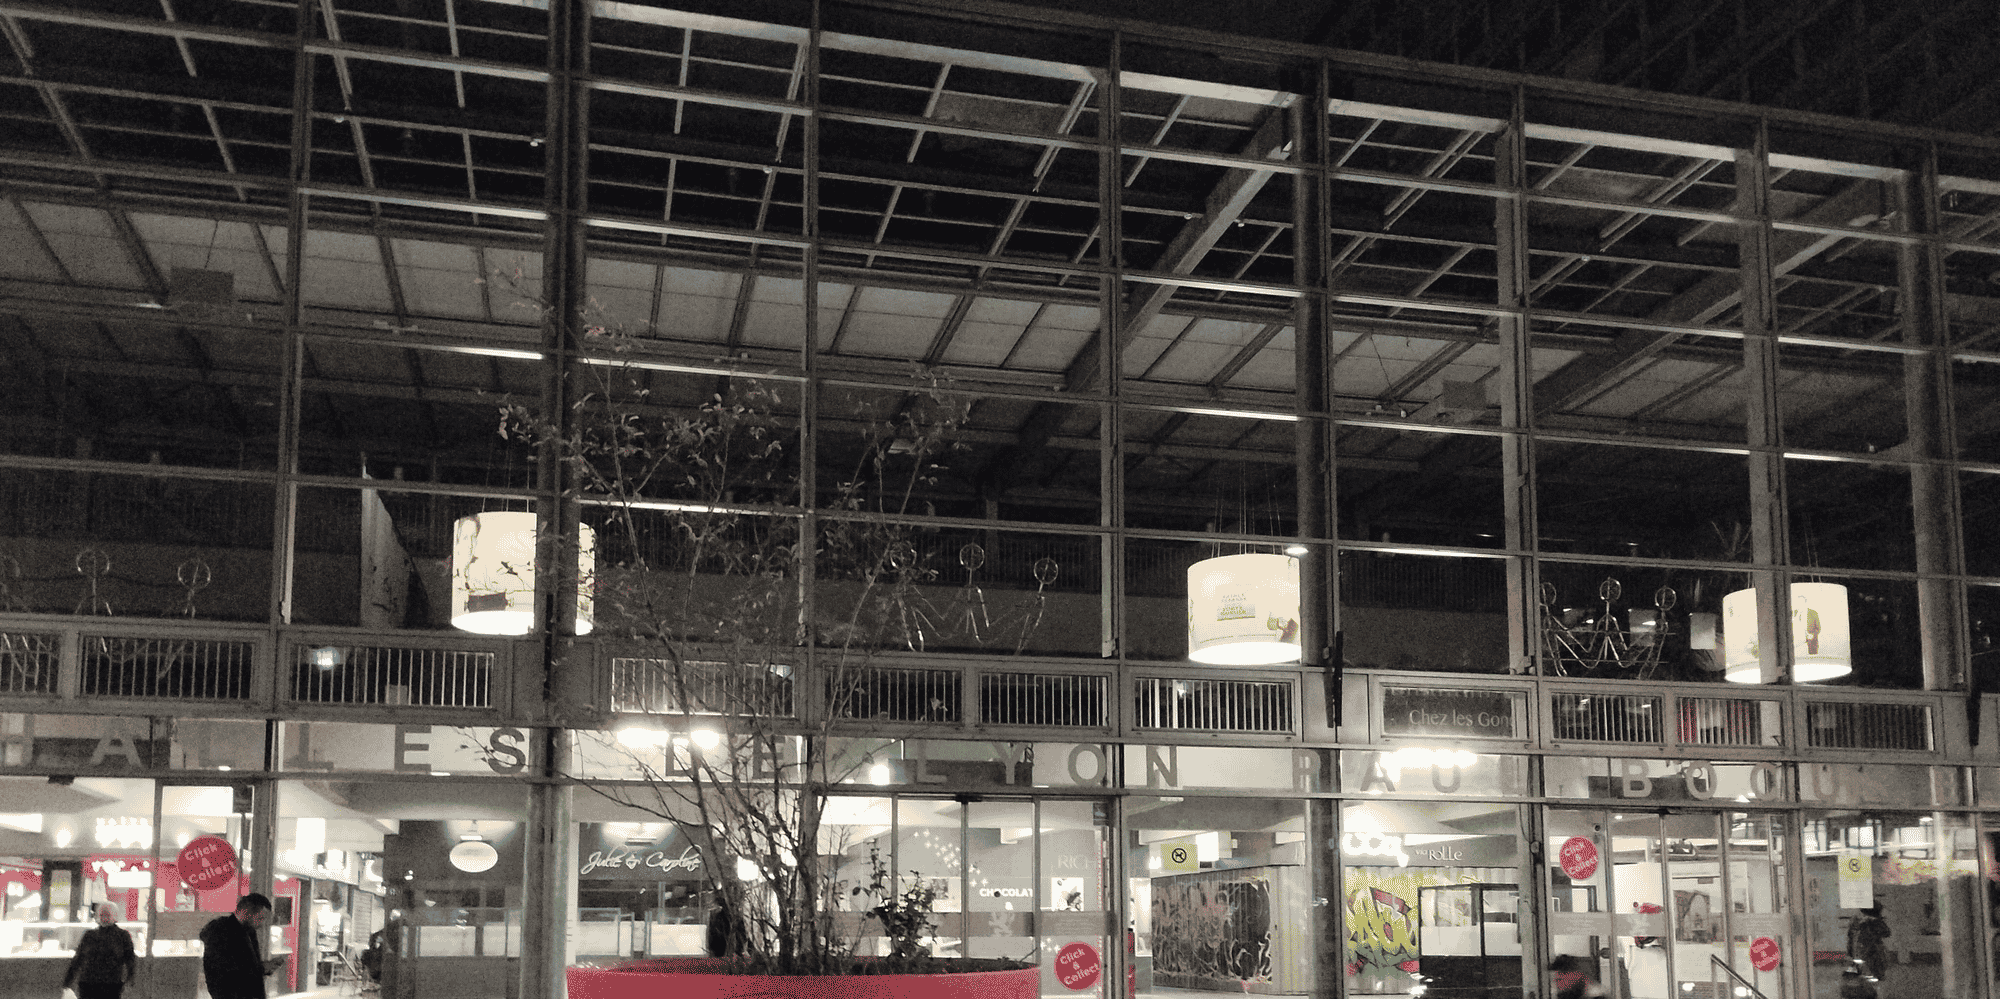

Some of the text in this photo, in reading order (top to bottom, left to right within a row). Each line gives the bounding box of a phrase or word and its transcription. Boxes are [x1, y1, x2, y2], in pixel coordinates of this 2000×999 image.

[1408, 707, 1448, 726] Chez
[1452, 709, 1474, 727] les
[916, 738, 1178, 788] LYON
[184, 843, 218, 861] Click
[1564, 842, 1584, 856] Click
[579, 845, 630, 875] Julie
[645, 844, 703, 873] Caroline
[1569, 855, 1598, 874] Collect
[188, 860, 235, 884] Collect
[1060, 948, 1085, 965] Click
[1063, 963, 1099, 985] Collect
